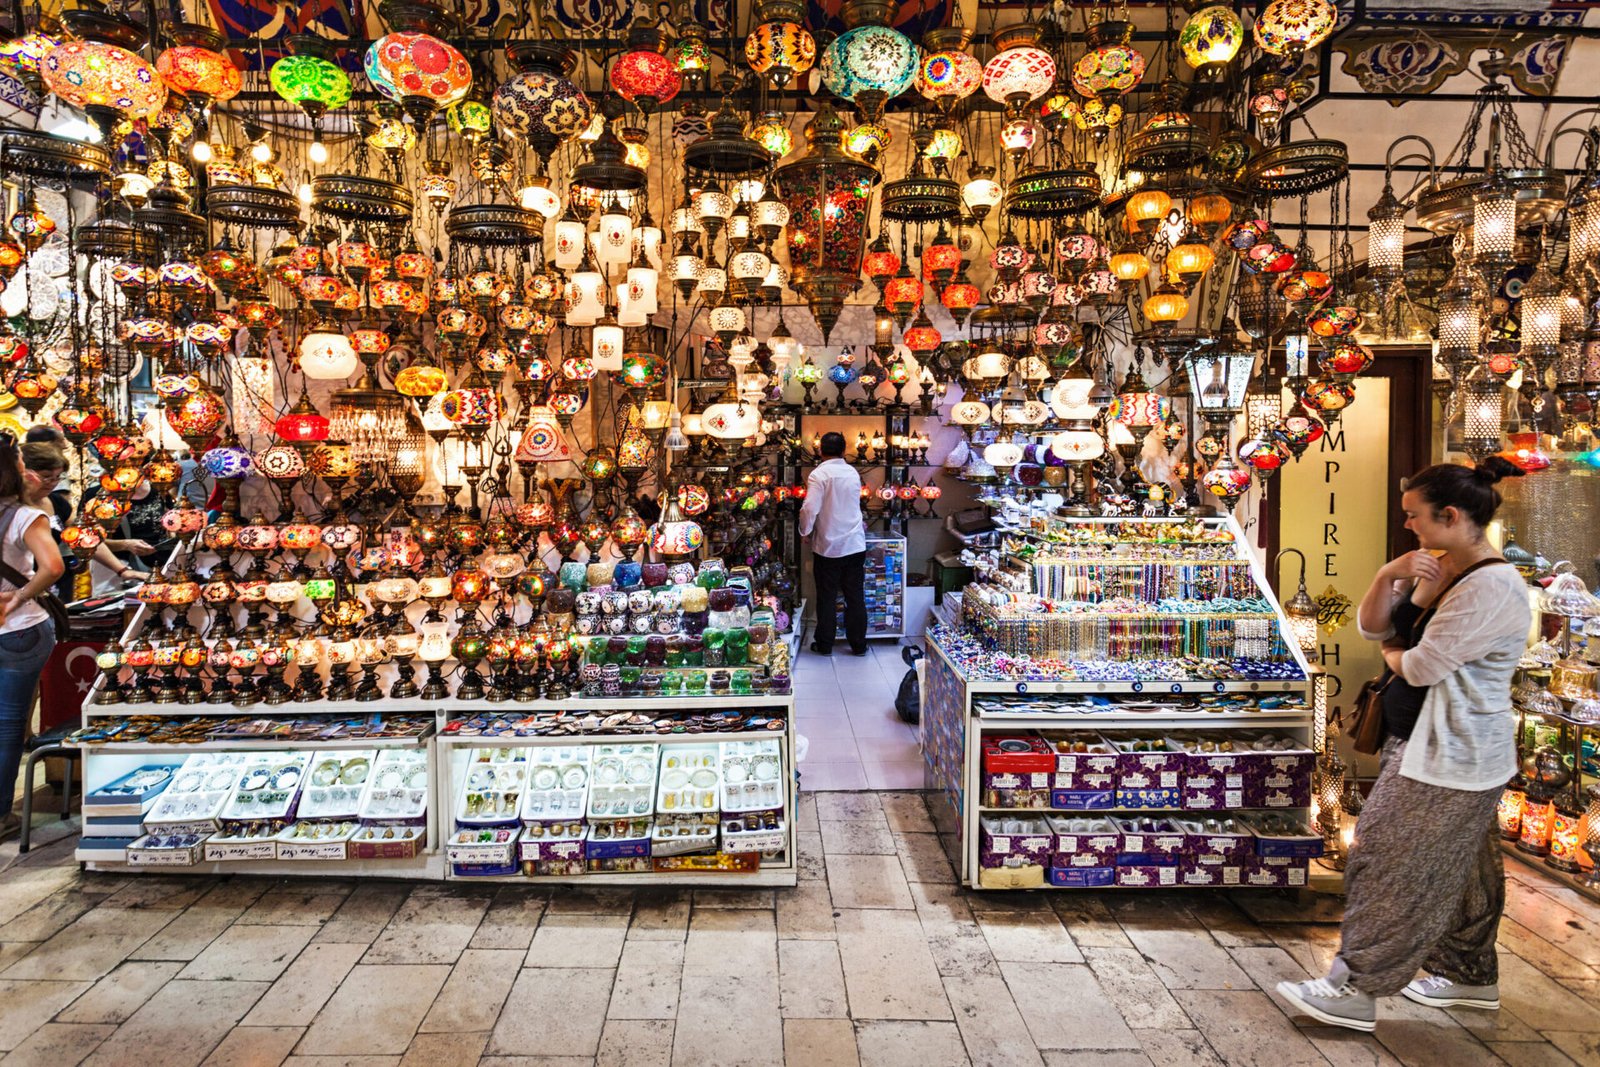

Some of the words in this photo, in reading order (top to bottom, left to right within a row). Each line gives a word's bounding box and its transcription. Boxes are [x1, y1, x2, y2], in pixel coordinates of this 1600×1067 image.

[1320, 416, 1346, 576] MPIRE
[209, 848, 227, 859] Set
[230, 848, 249, 857] Tea
[281, 848, 298, 858] Set
[300, 848, 319, 856] Tea
